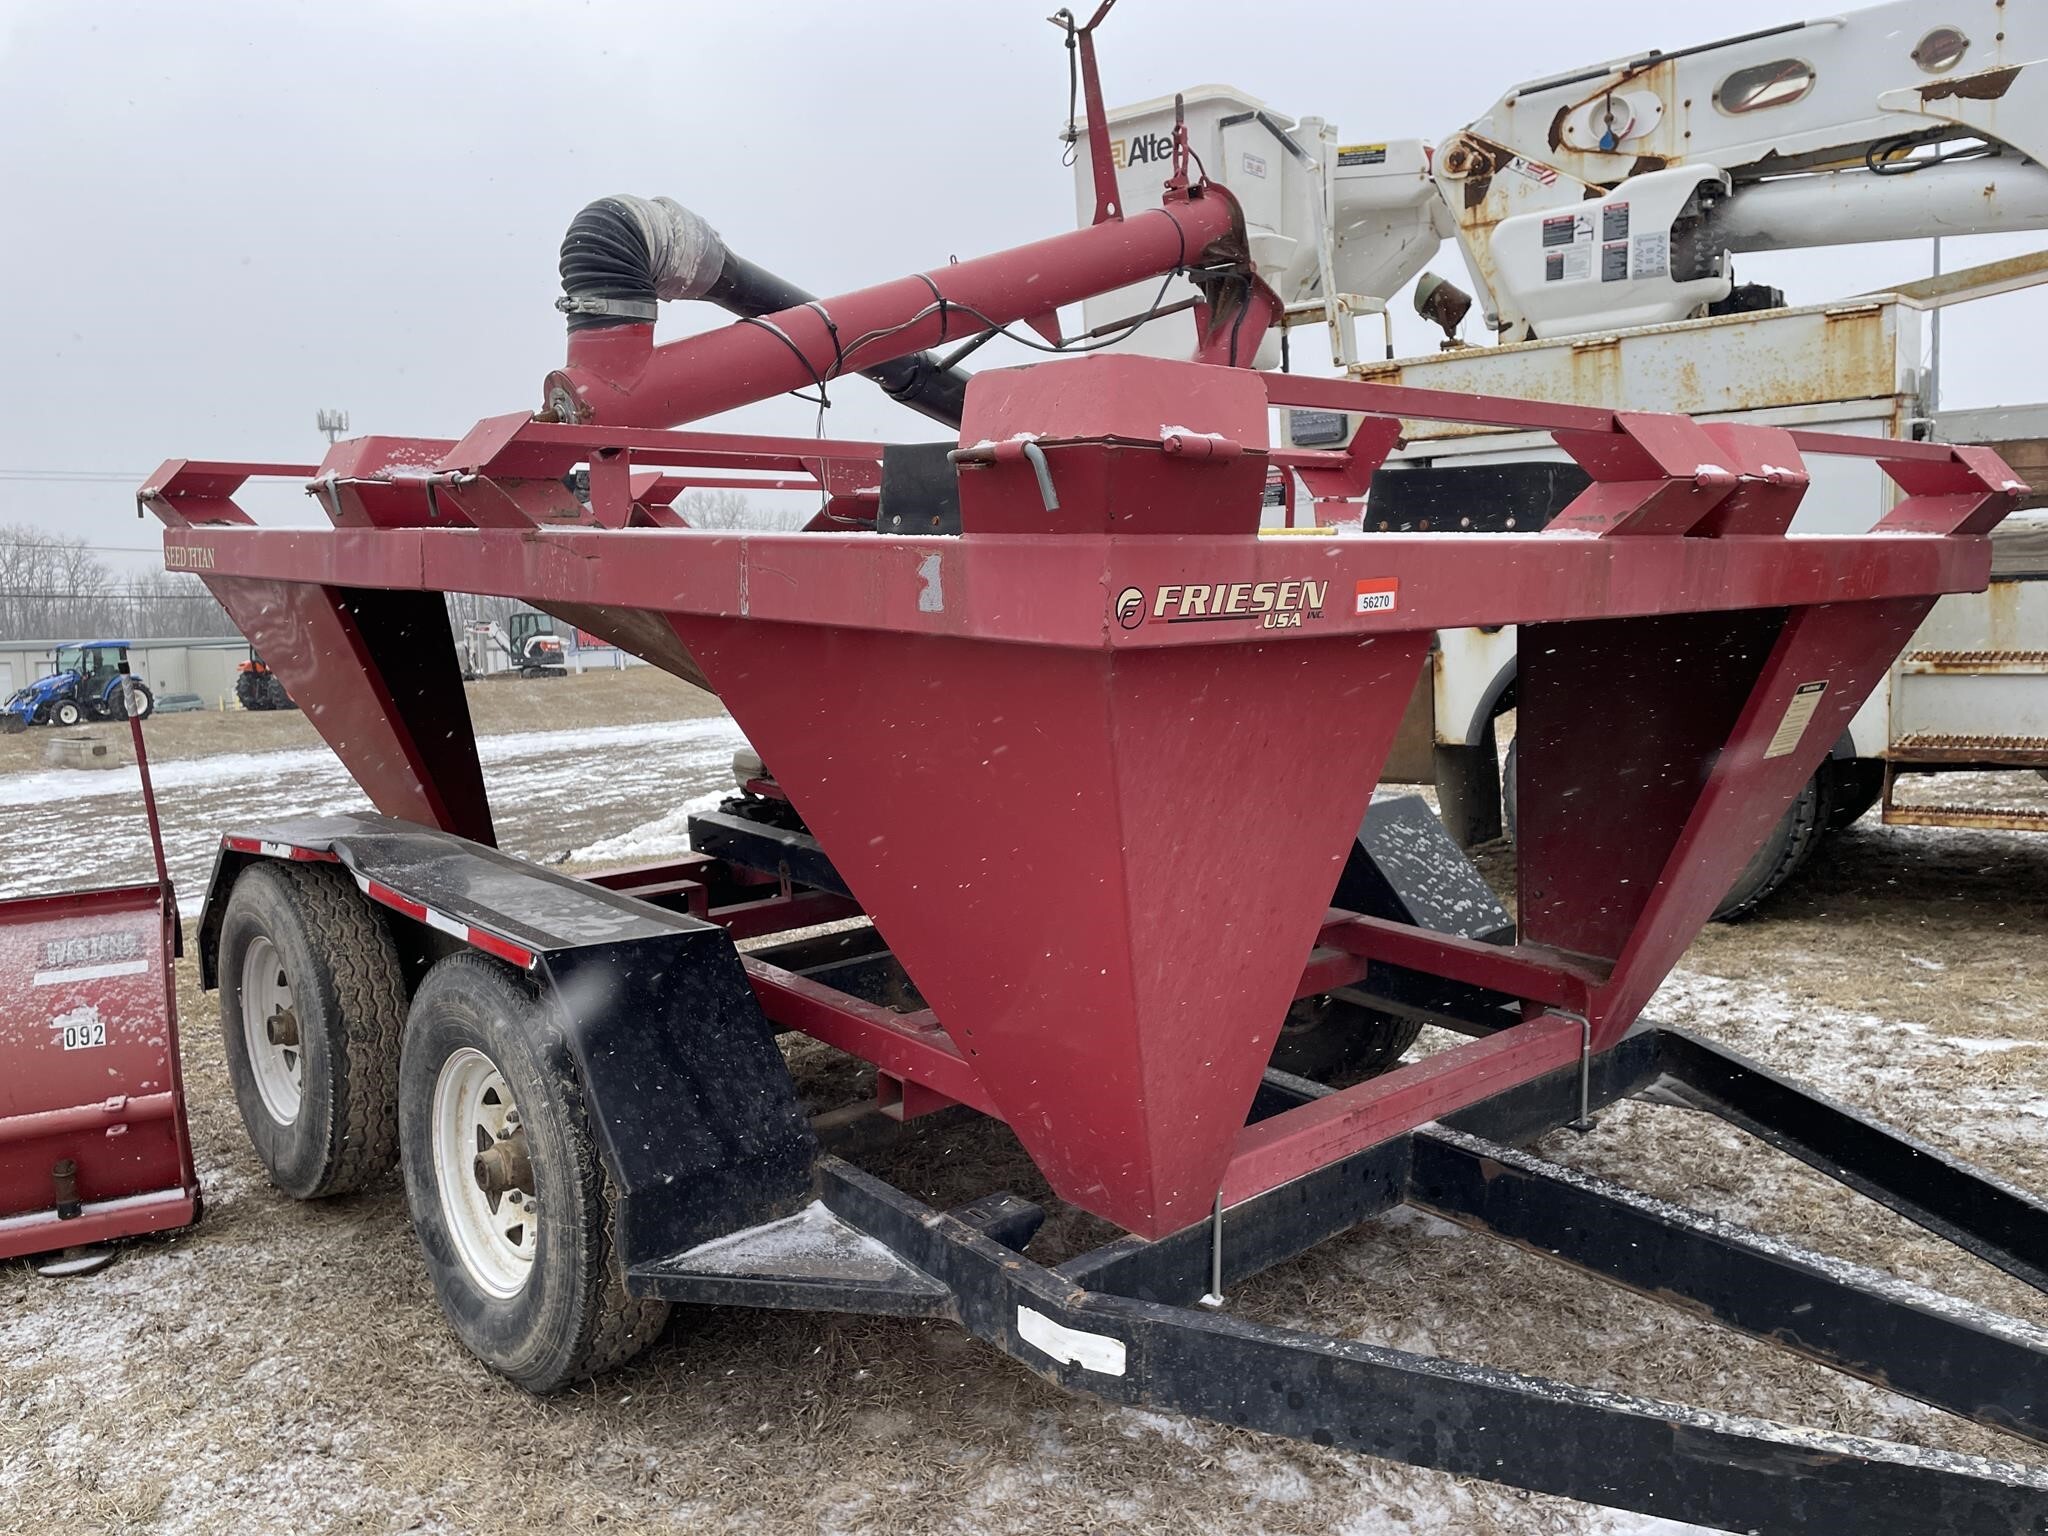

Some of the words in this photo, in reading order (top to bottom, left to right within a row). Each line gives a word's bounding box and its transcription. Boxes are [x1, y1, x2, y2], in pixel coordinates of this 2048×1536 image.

[1128, 133, 1177, 167] Alte
[165, 546, 187, 567] SEED
[187, 547, 215, 568] TITAN
[1152, 580, 1329, 616] FRIESEN
[1363, 595, 1390, 609] 56270
[1262, 611, 1302, 629] USA
[1307, 611, 1325, 619] INC.
[66, 1025, 104, 1047] 092
